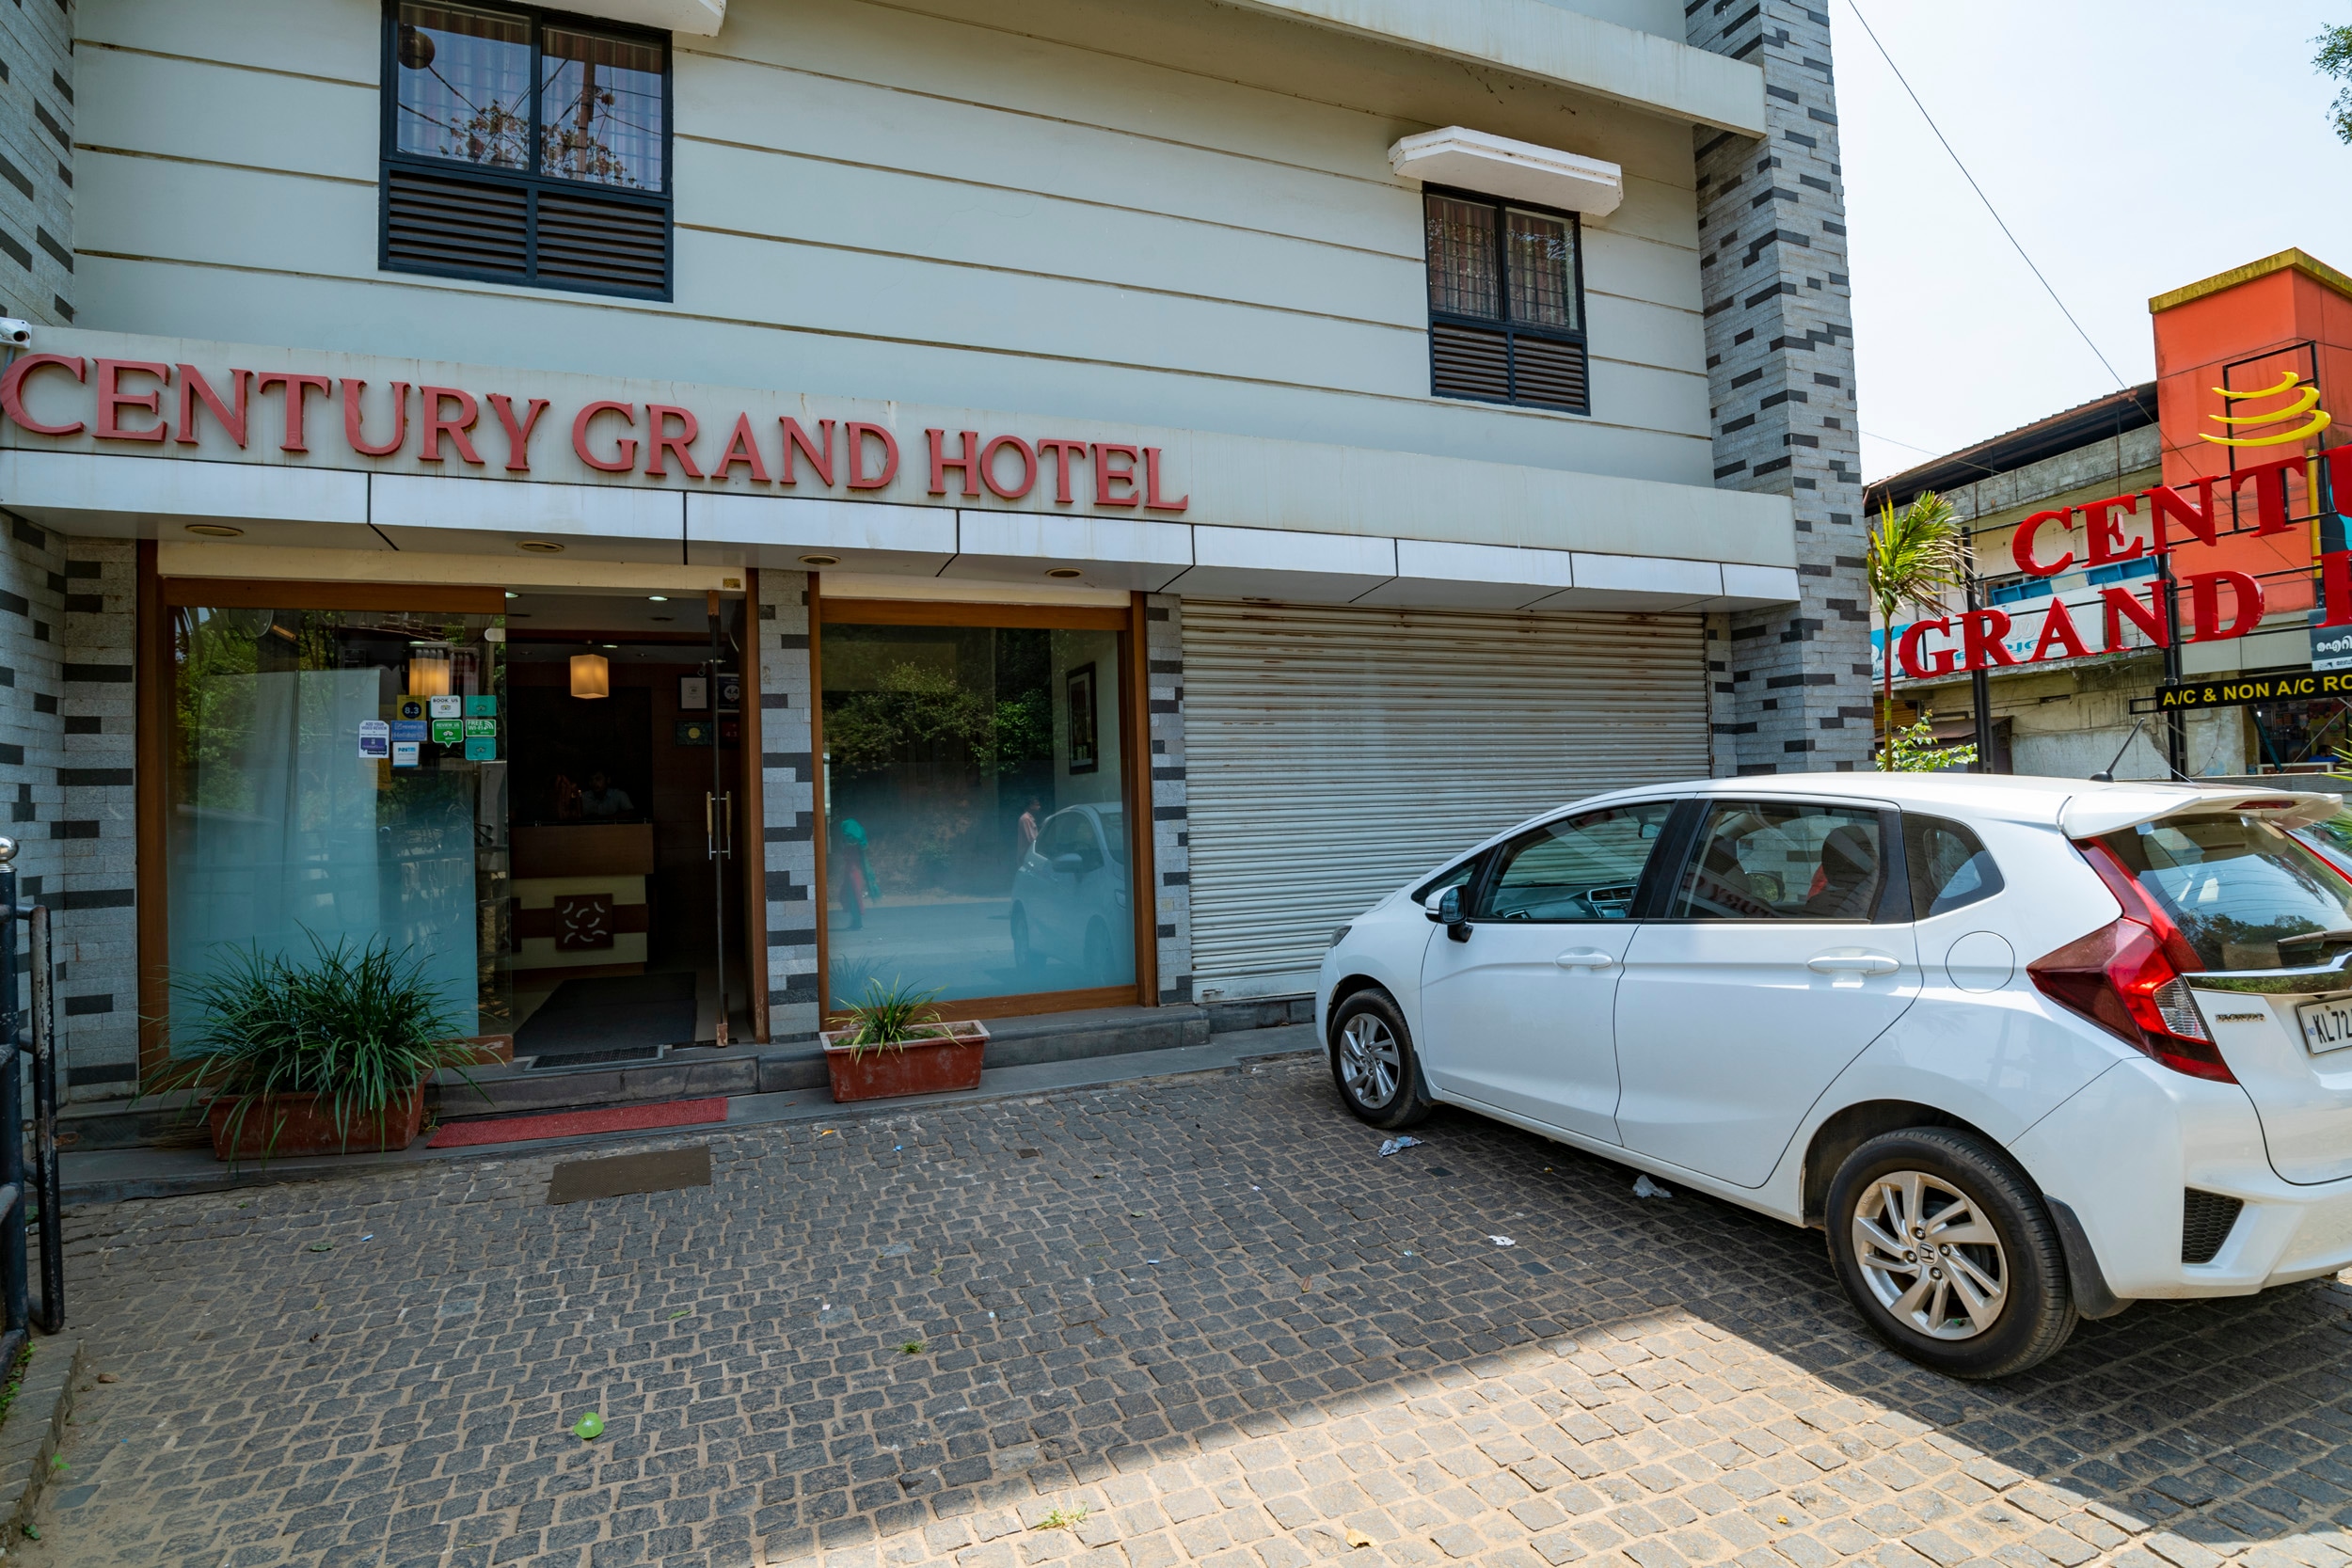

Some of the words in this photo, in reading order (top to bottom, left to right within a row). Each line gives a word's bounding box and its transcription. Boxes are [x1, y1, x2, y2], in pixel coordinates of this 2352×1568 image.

[0, 353, 549, 471] CENTURY
[571, 400, 899, 489] GRAND
[924, 428, 1189, 512] HOTEL
[1898, 570, 2265, 679] GRAND
[2162, 689, 2197, 706] A/C
[2202, 687, 2217, 703] &
[2223, 682, 2270, 701] NON
[2276, 677, 2315, 696] A/C
[405, 706, 420, 715] 8.3
[2312, 1008, 2352, 1044] KL72
